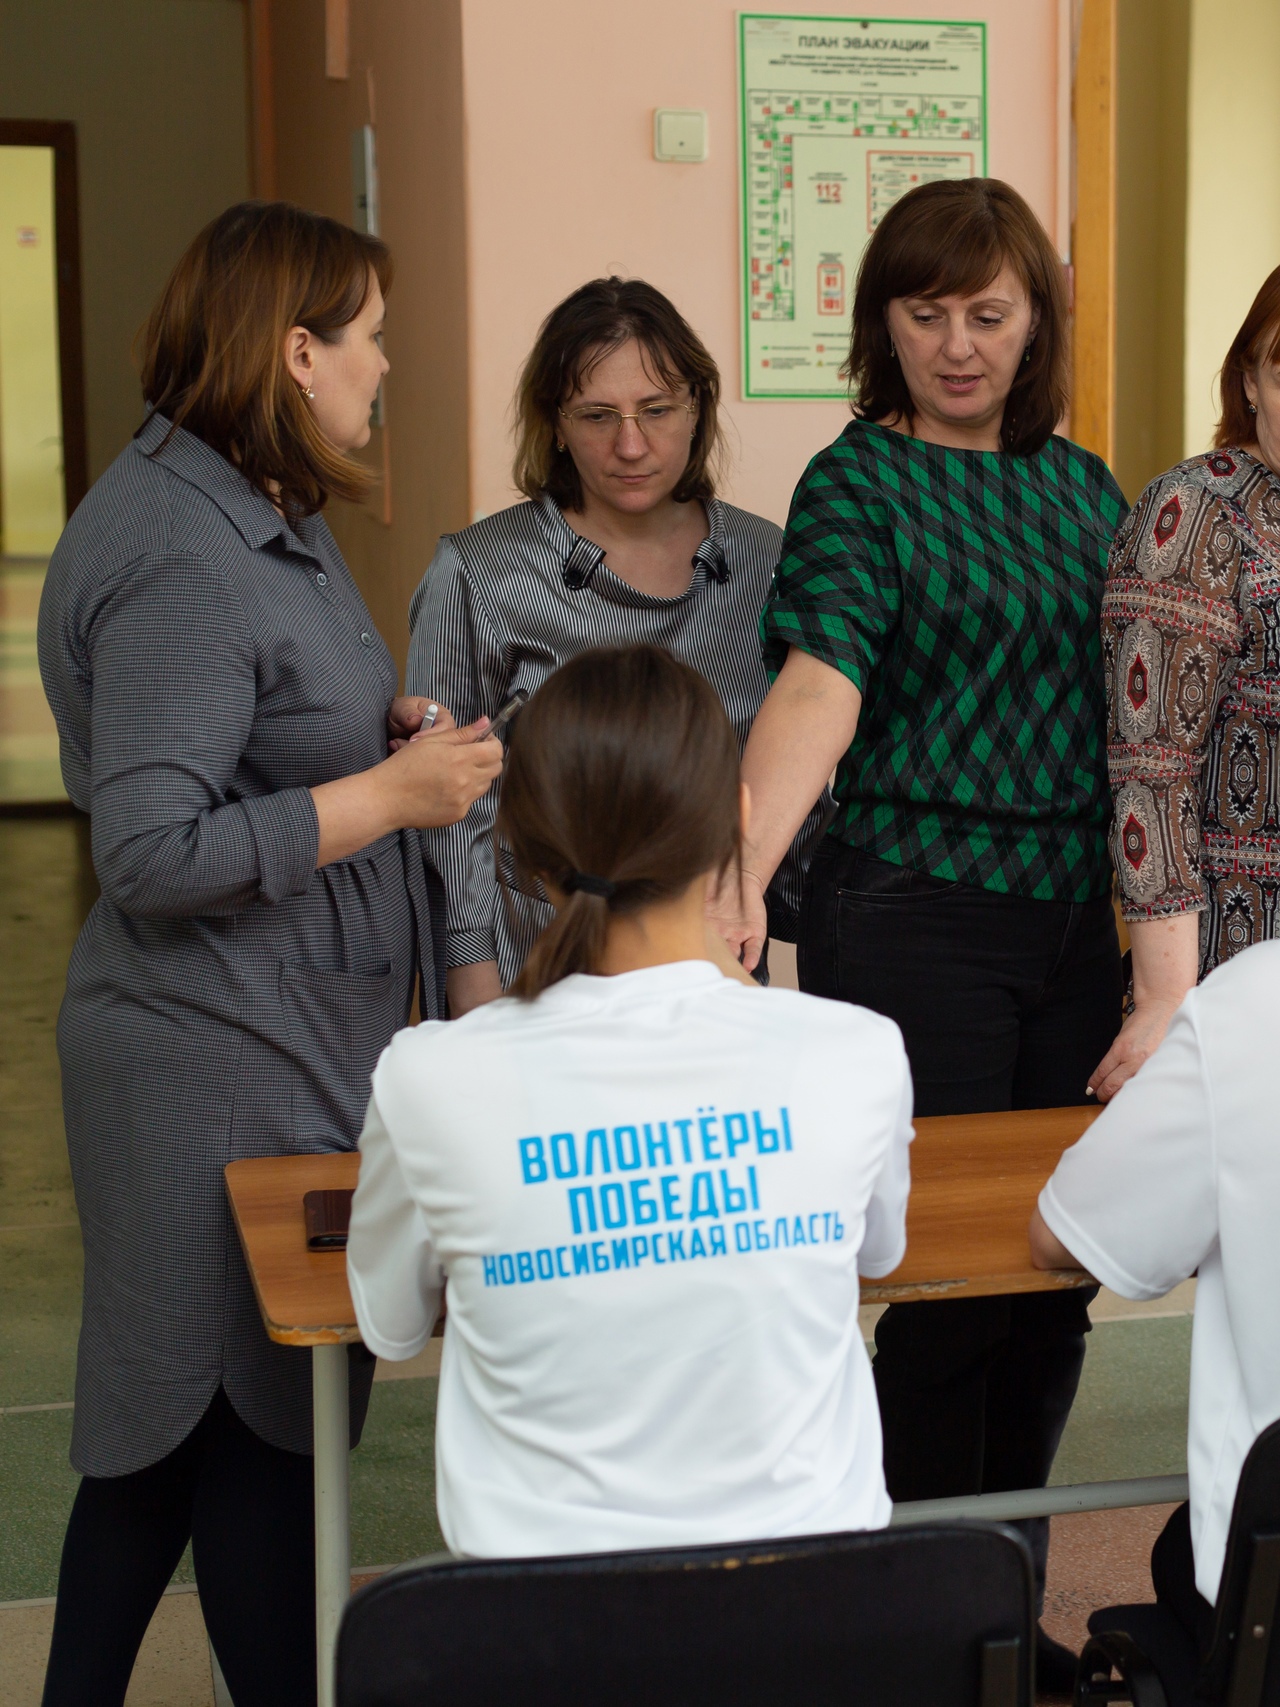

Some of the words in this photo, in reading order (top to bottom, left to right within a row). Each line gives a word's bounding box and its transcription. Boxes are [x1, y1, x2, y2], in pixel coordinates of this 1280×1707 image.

[798, 35, 839, 48] ПЛАН
[843, 37, 930, 51] ЭВАКУАЦИИ
[815, 183, 842, 199] 112
[518, 1107, 793, 1185] ВОЛОНТЁРЫ
[567, 1165, 760, 1235] ПОБЕДЫ
[482, 1225, 727, 1287] НОВОСИБИРСКАЯ
[735, 1211, 844, 1253] ОБЛАСТЬ
